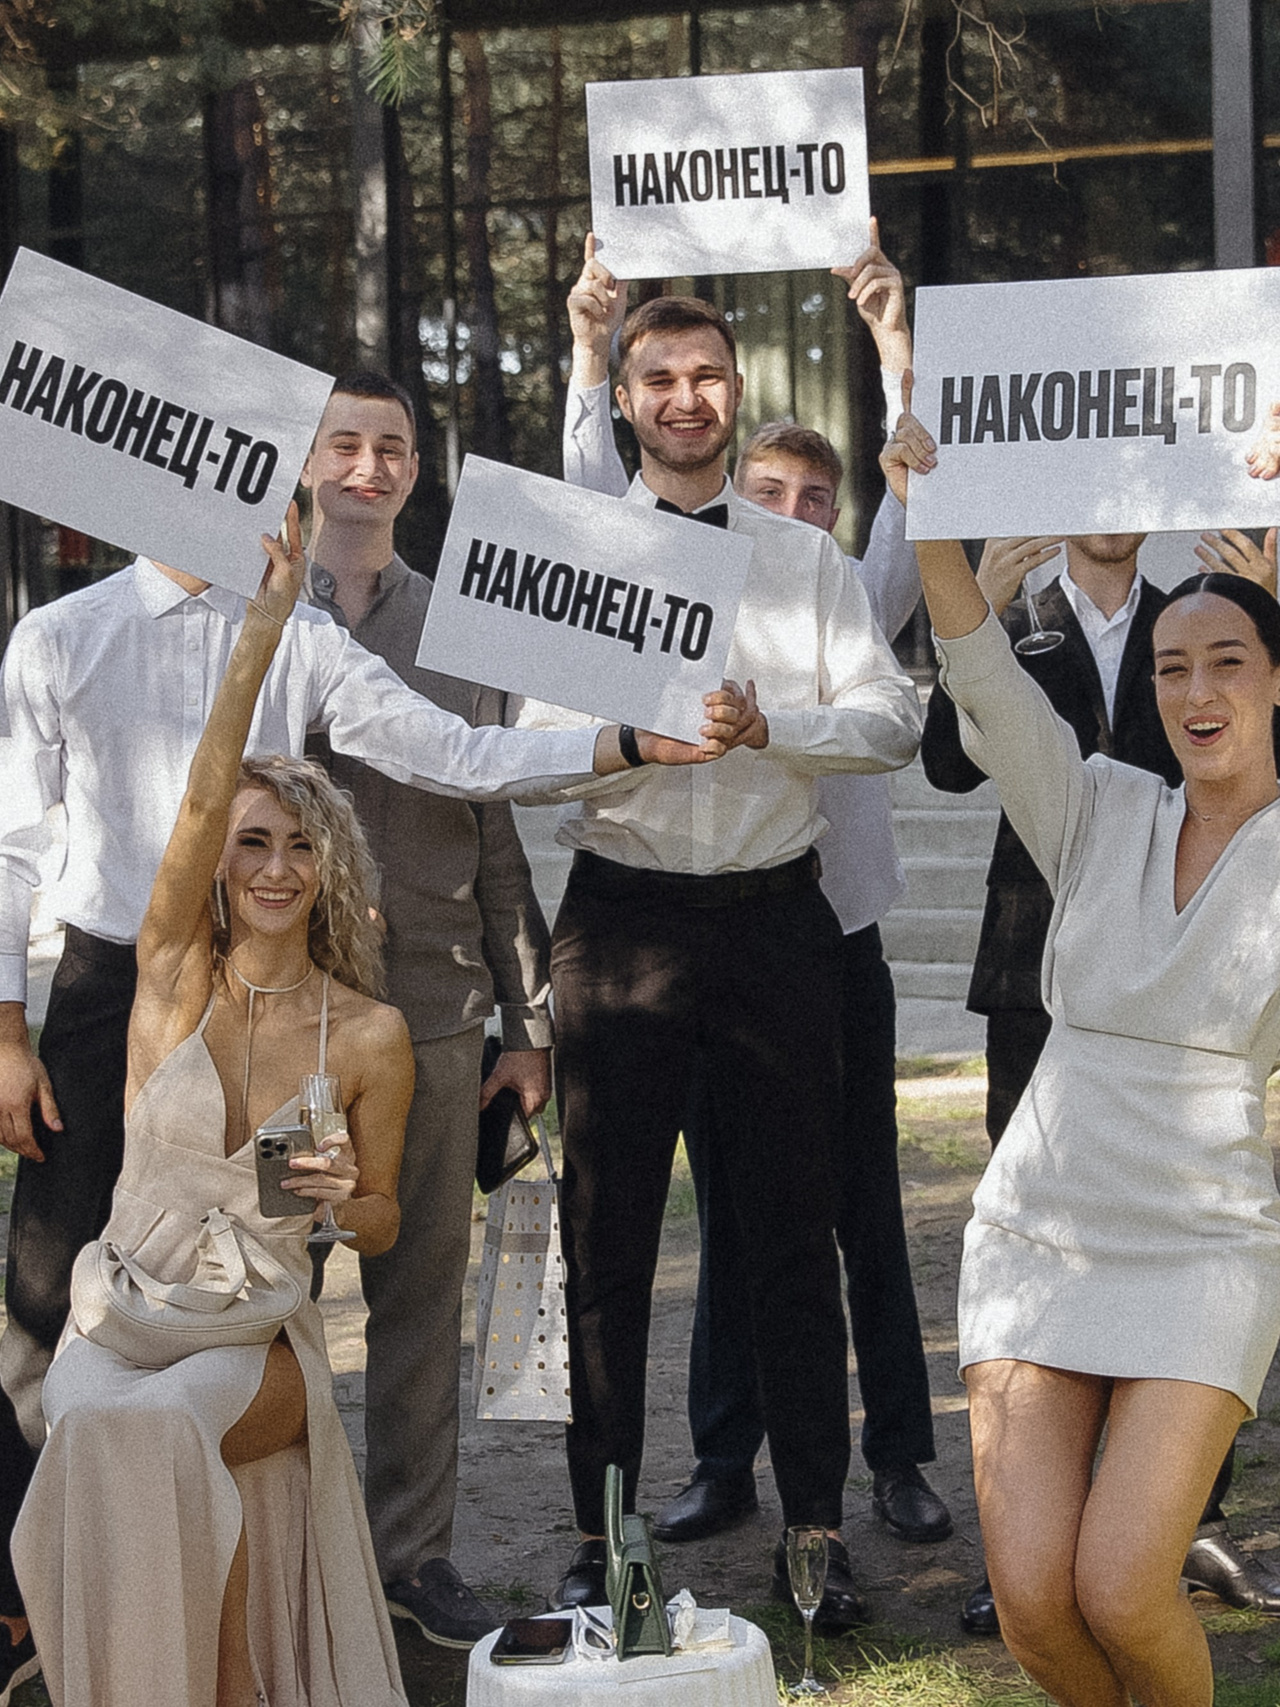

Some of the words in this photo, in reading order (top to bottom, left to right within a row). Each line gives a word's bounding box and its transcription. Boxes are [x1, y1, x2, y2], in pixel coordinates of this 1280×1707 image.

[612, 141, 846, 208] НАКОНЕЦ-ТО
[939, 362, 1257, 445] НАКОНЕЦ-ТО
[459, 537, 715, 662] НАКОНЕЦ-ТО
